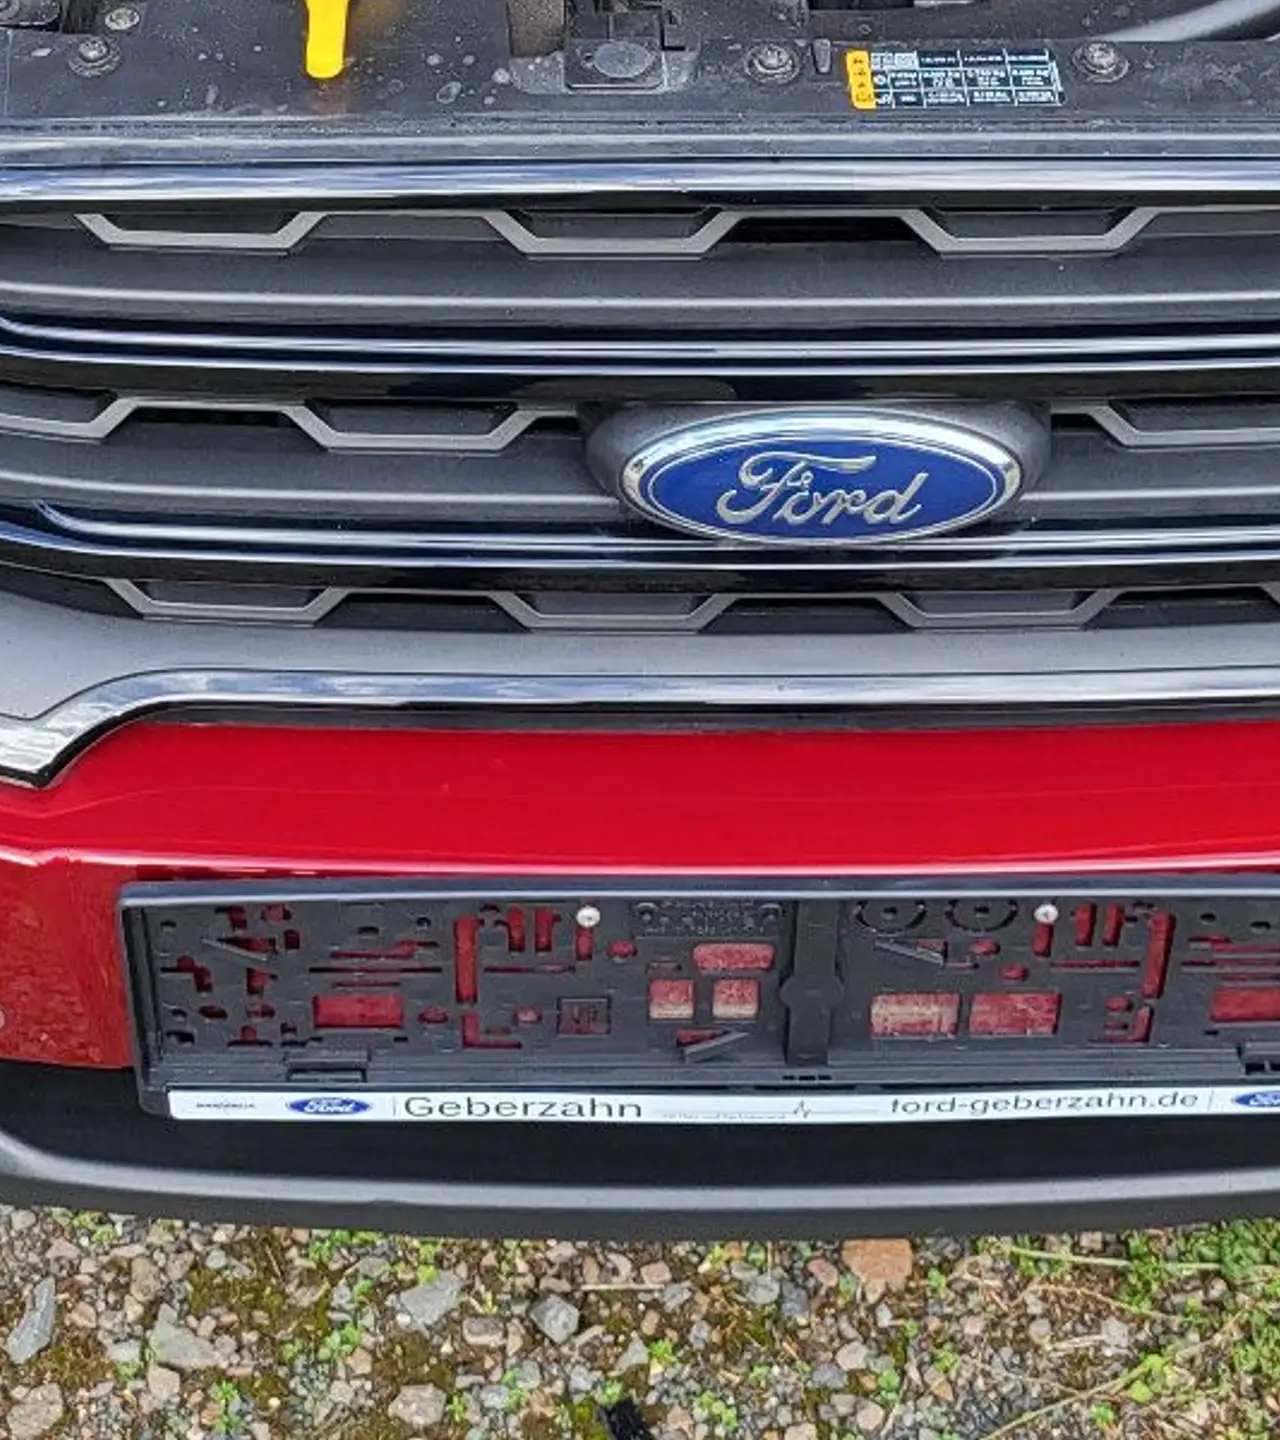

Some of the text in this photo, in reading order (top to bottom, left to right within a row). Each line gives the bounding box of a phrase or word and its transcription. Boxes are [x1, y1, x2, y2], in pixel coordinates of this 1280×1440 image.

[716, 450, 929, 526] Ford
[404, 1096, 642, 1118] Geberzahn
[890, 1090, 1199, 1115] ford-geberzahn.de
